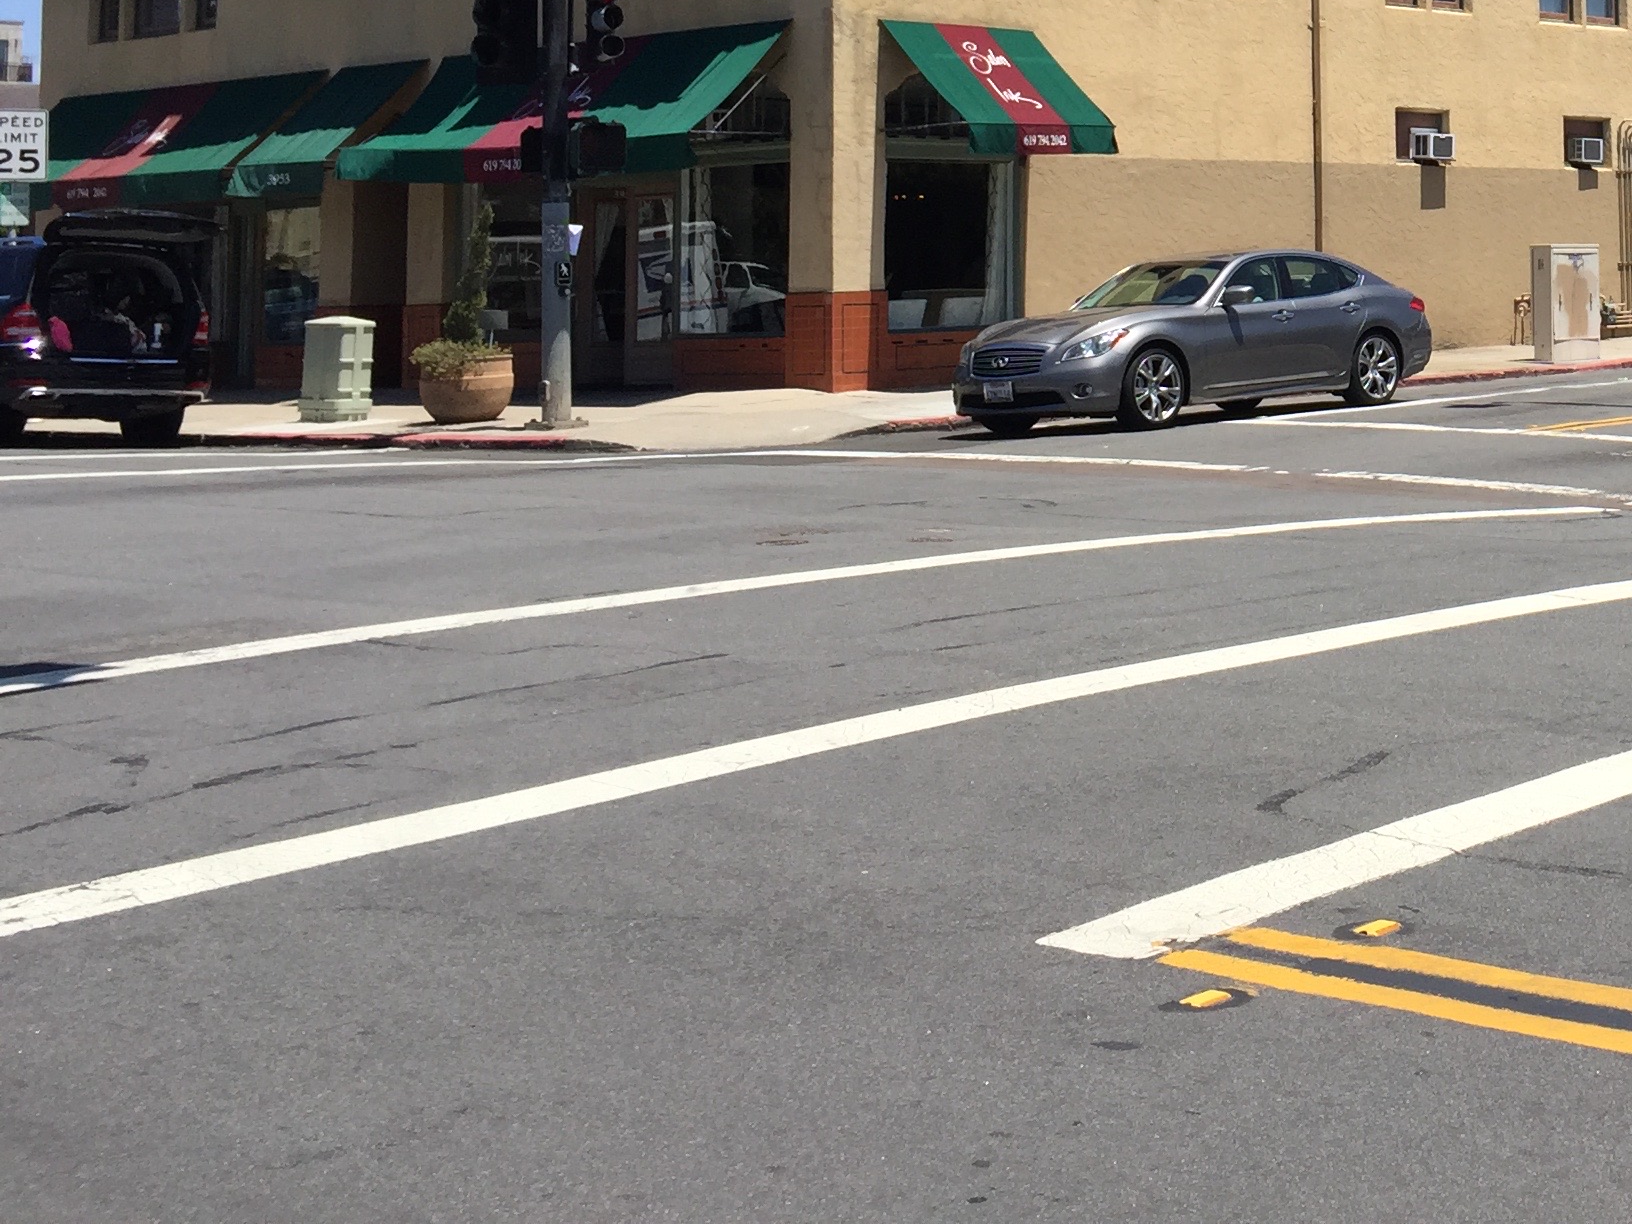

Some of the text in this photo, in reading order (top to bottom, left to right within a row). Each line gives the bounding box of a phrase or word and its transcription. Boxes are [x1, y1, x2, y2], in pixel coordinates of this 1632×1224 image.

[0, 116, 44, 128] PEED
[0, 132, 38, 143] IMIT
[0, 148, 40, 174] 25
[483, 160, 498, 172] 619
